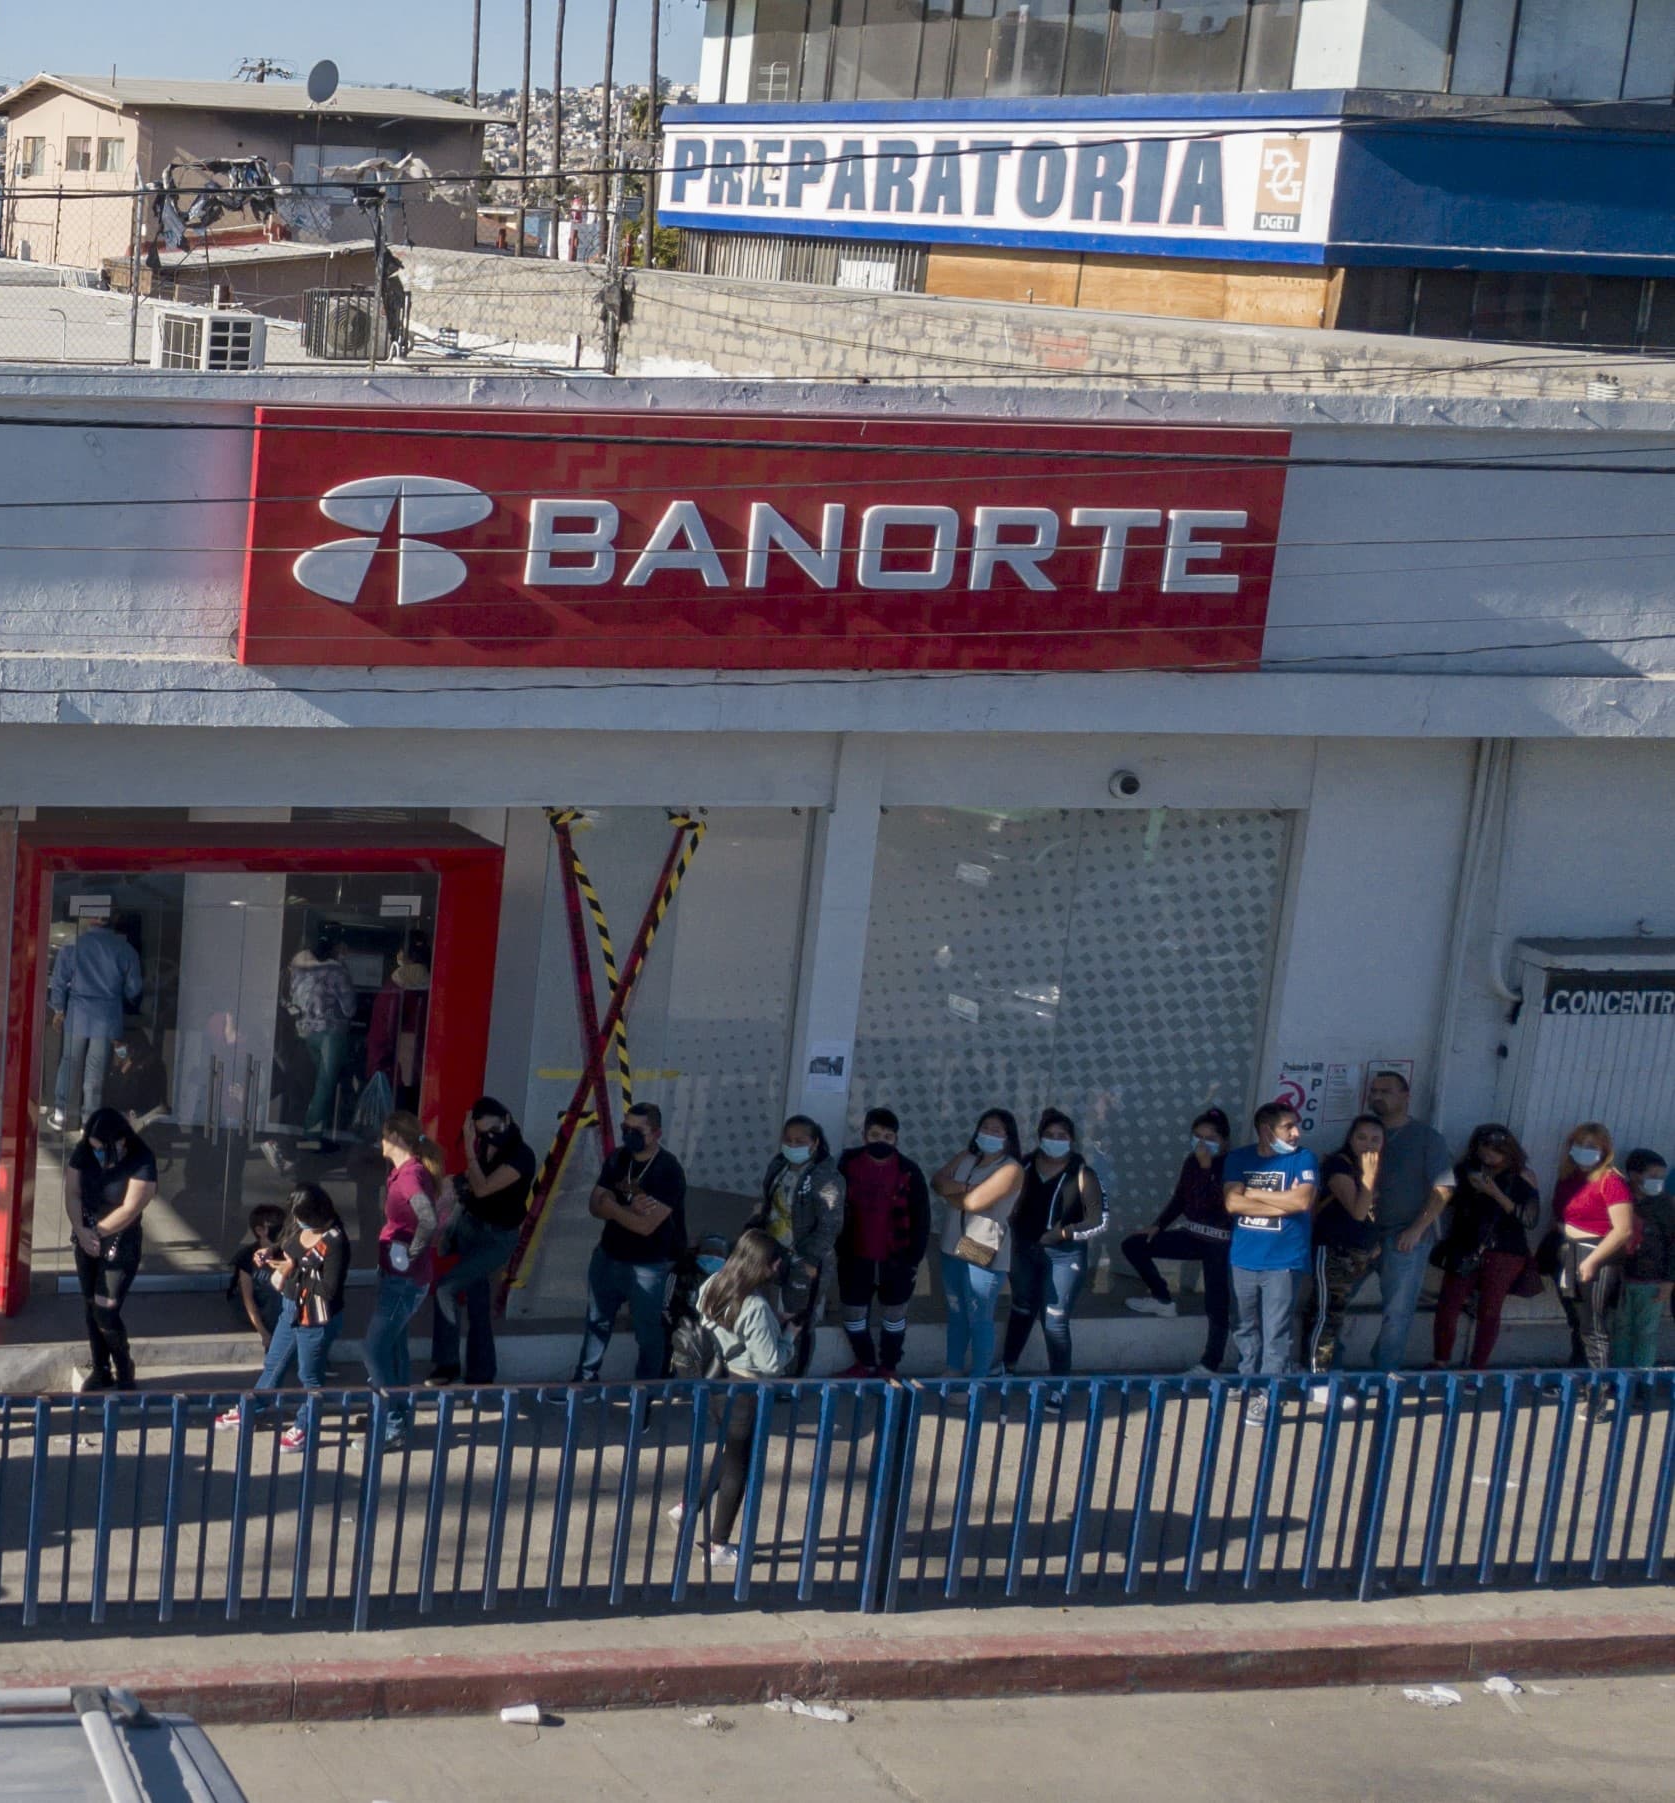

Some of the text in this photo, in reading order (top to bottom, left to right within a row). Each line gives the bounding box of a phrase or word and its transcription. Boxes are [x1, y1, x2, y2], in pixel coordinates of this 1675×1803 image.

[670, 137, 1227, 227] PREPARATORIA
[1259, 214, 1294, 230] DGETI
[523, 499, 1248, 593] BANORTE
